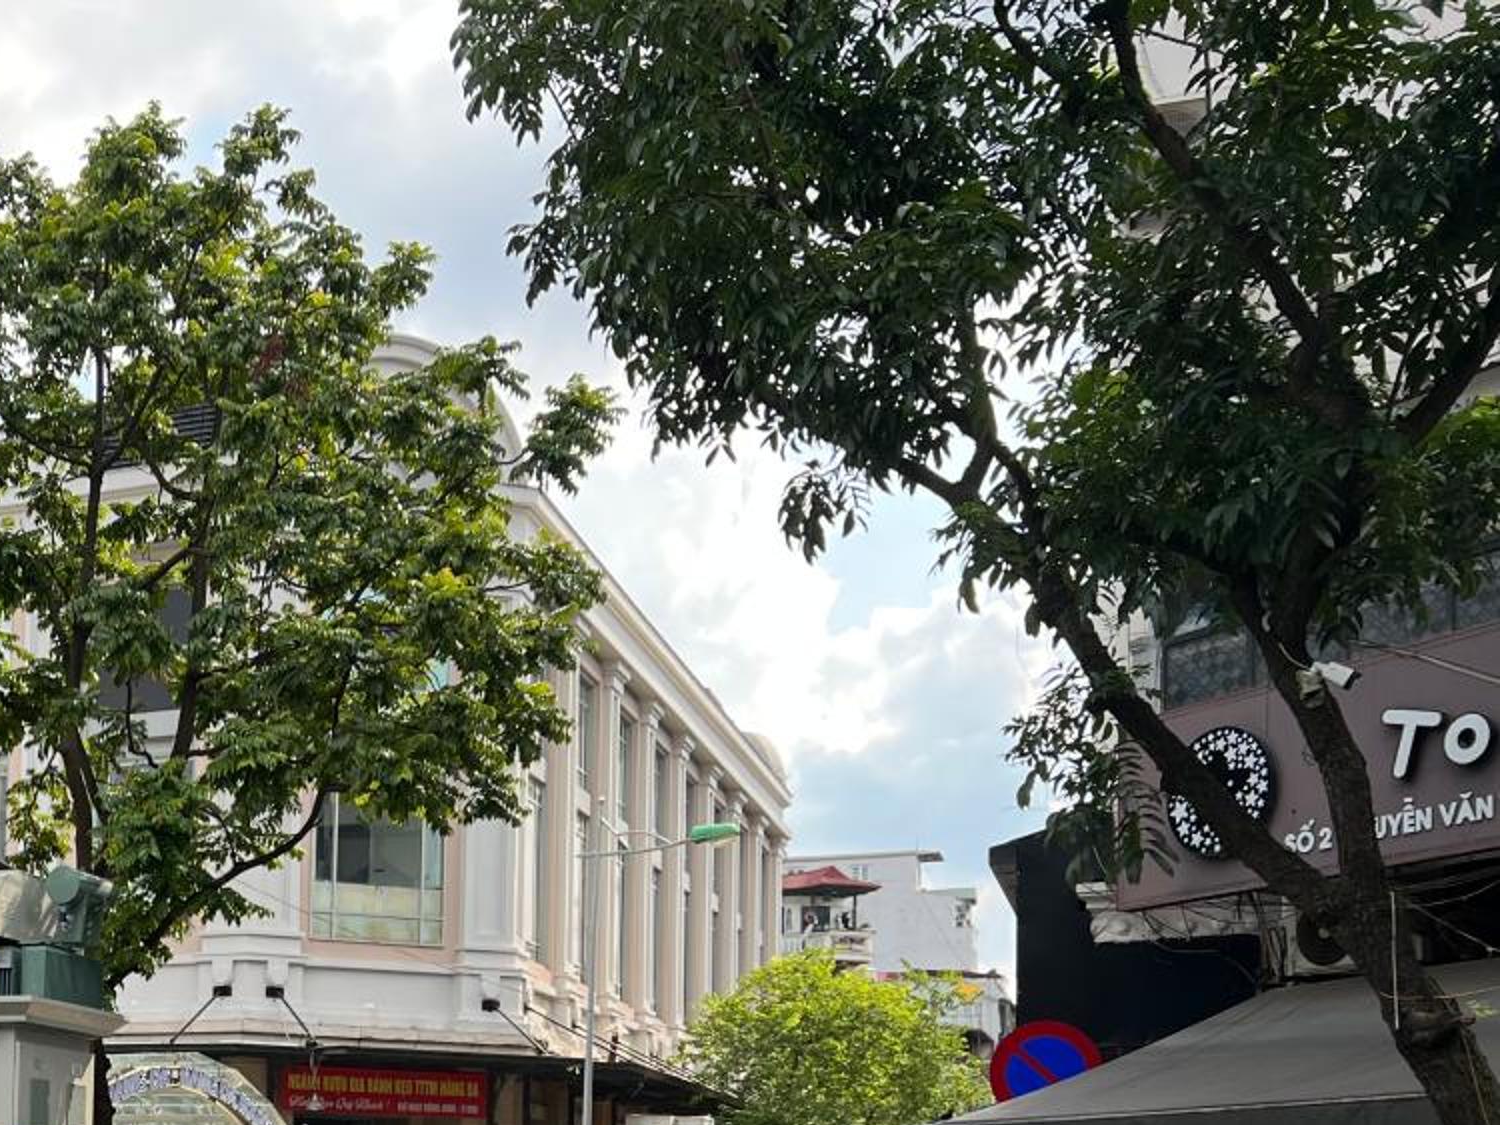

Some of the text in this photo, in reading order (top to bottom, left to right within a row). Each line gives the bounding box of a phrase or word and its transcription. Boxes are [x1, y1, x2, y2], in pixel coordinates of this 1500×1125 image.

[1381, 709, 1491, 778] TO
[1285, 820, 1315, 853] SỐ
[1374, 797, 1433, 838] UYỄN
[1440, 791, 1494, 827] VĂN
